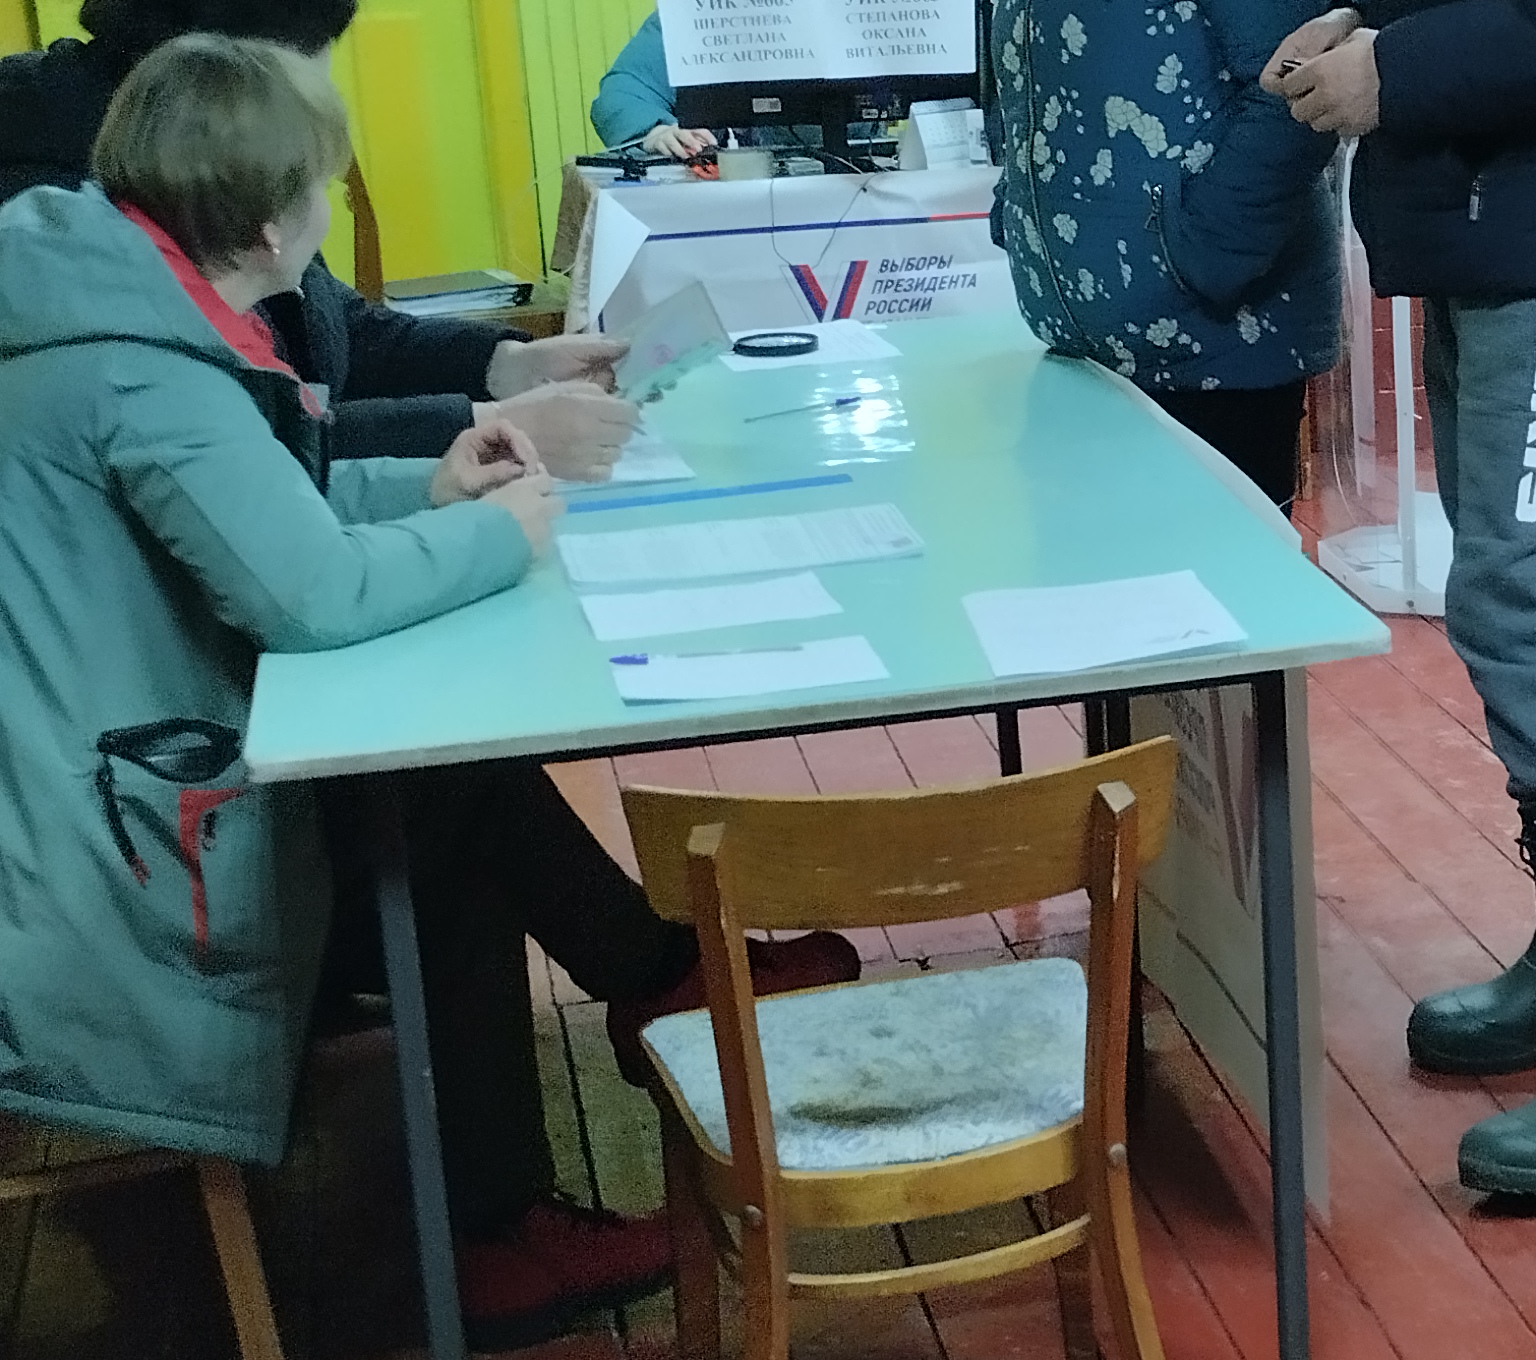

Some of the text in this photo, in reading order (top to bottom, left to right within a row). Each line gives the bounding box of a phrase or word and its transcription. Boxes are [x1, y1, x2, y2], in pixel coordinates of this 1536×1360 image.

[845, 9, 940, 24] СТЕПАНОВА
[702, 32, 787, 47] СВЕТЛАНА
[861, 27, 927, 41] ОКСАНА
[680, 48, 815, 66] АЛЕКСАНДРОВНА
[845, 43, 947, 59] ВИТАЛЬЕВНА
[878, 254, 954, 274] ВЫБОРЫ
[871, 273, 977, 295] ПРЕЗИДЕНТА
[865, 296, 933, 316] РОССИИ
